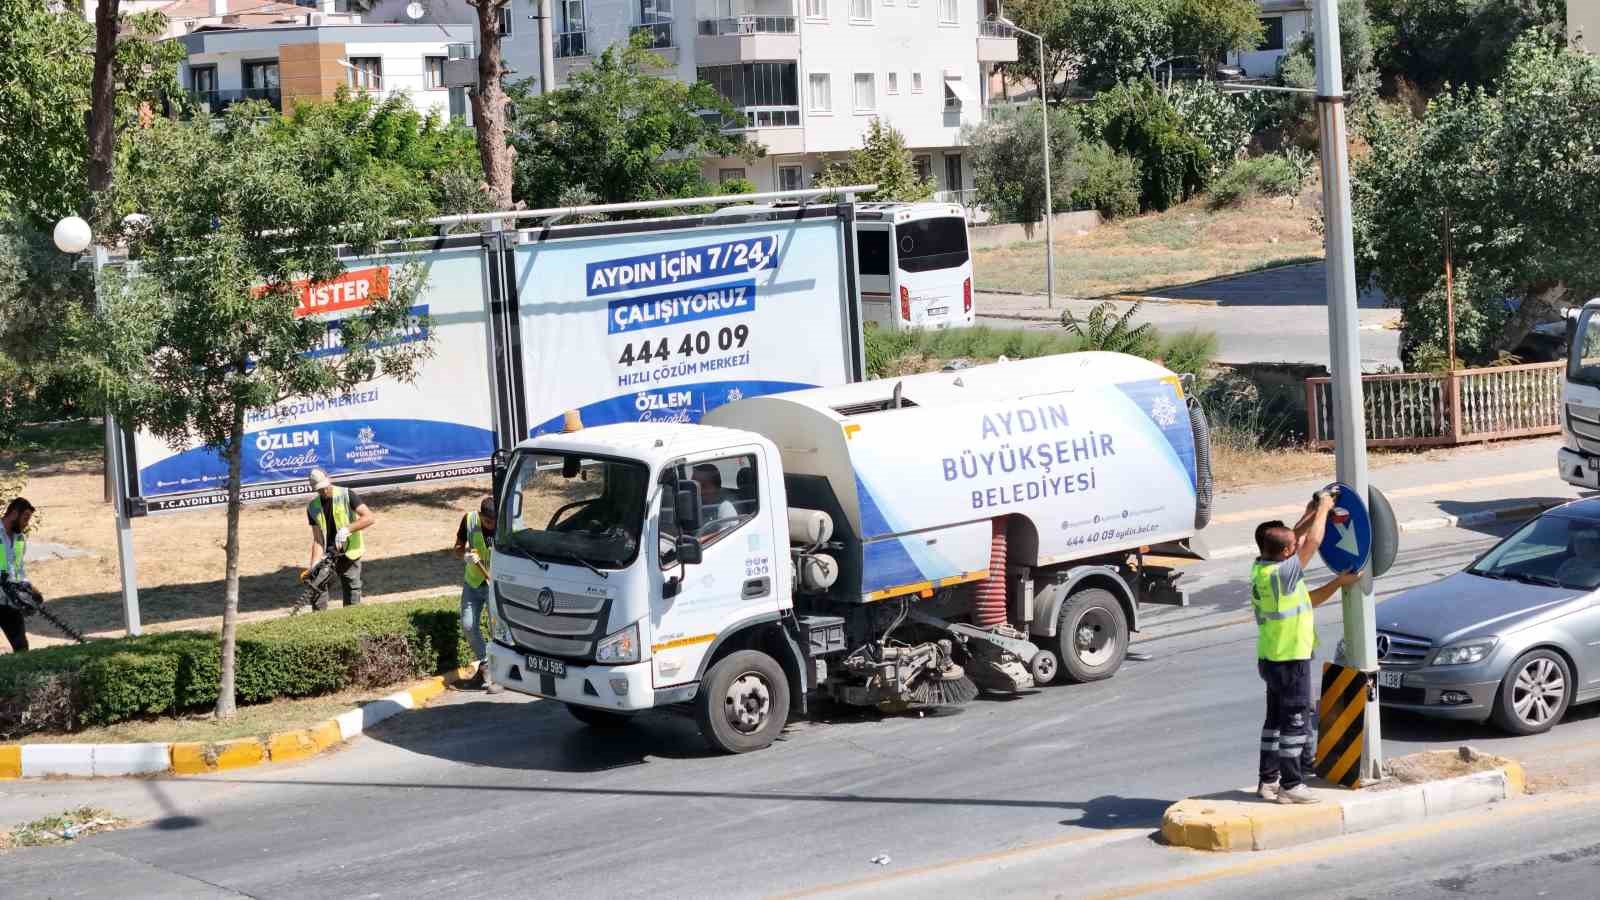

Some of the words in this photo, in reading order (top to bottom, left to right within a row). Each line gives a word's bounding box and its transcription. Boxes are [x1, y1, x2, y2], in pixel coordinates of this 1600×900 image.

[591, 261, 656, 290] AYDIN
[661, 252, 702, 283] İÇİN
[309, 279, 370, 307] İSTER
[614, 287, 748, 330] ÇALIŞIYORUZ
[618, 337, 670, 366] 444
[677, 330, 711, 357] 40
[718, 324, 749, 351] 09
[618, 370, 650, 387] HIZLI
[653, 361, 697, 384] ÇÖZÜM
[700, 350, 750, 373] MERKEZİ
[635, 390, 692, 411] ÖZLEM
[981, 404, 1070, 440] AYDIN
[256, 430, 320, 451] ÖZLEM
[942, 430, 1116, 482] BÜYÜKŞEHİR
[446, 466, 485, 476] OUTDOOR
[972, 466, 1096, 509] BELEDİYESİ
[1066, 535, 1085, 546] 444
[1087, 532, 1100, 543] 40
[1101, 529, 1115, 540] 09
